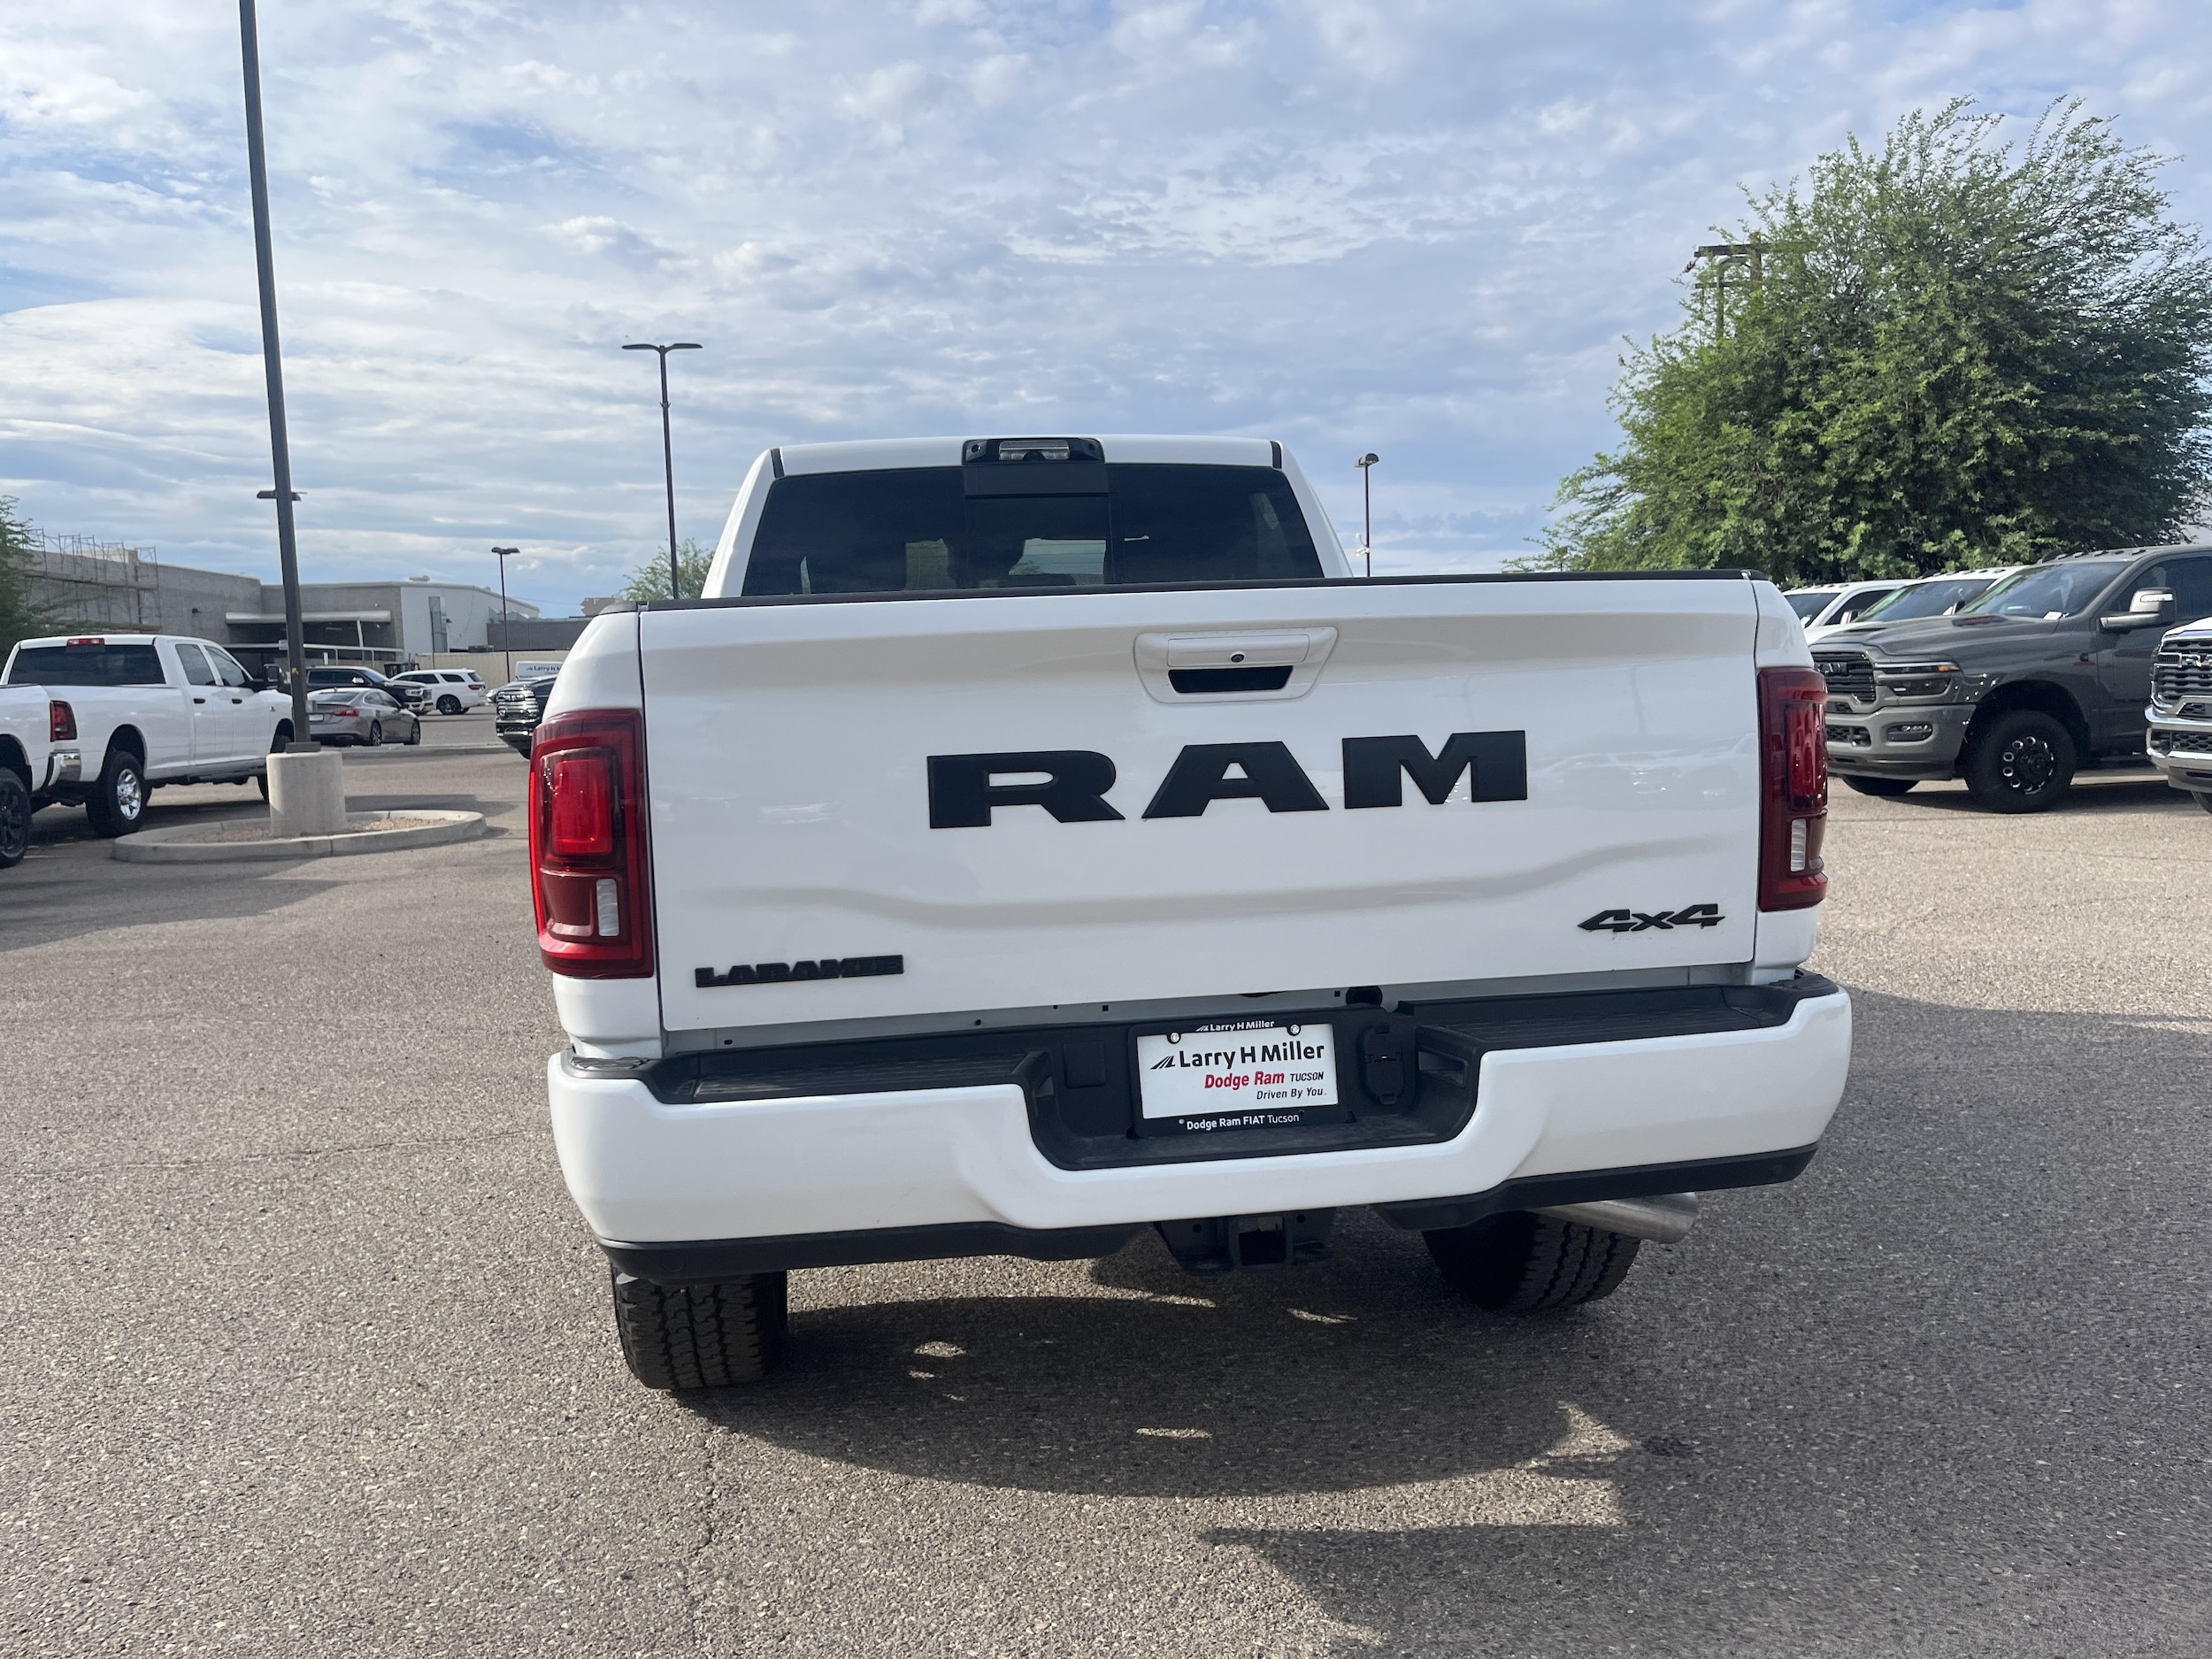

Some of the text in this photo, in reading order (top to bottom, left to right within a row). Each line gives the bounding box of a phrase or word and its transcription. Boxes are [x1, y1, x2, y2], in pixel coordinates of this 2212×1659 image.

[927, 730, 1527, 828] RAM
[1578, 903, 1725, 932] 4x4
[1210, 1023, 1235, 1032] Larry
[1246, 1020, 1275, 1029] Miller
[1179, 1041, 1325, 1069] Larry H Miller
[1204, 1071, 1324, 1090] Dodge Ram TUCSON
[1256, 1090, 1287, 1100] Driven
[1291, 1088, 1302, 1099] By
[1187, 1113, 1300, 1131] Dodge Ram FIAT Tucson
